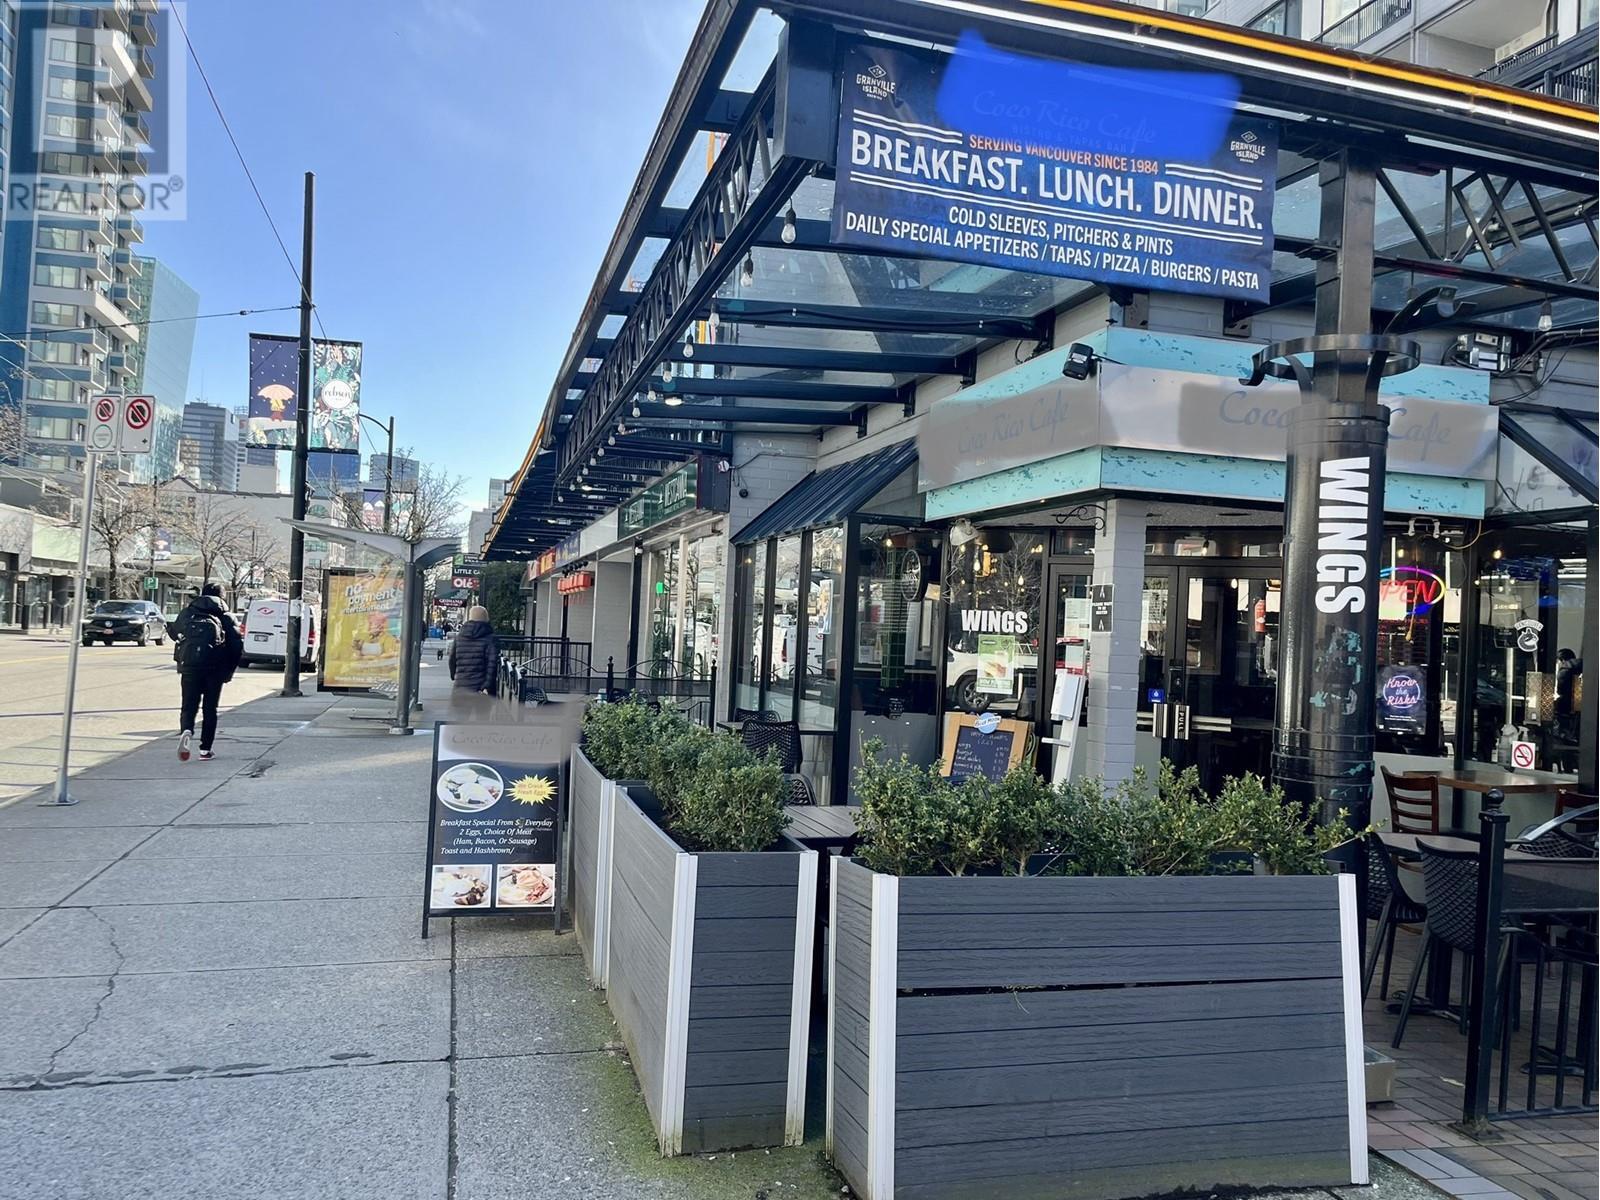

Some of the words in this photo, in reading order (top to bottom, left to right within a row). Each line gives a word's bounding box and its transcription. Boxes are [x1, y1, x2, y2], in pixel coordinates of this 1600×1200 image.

[856, 74, 896, 94] GRANVILLE
[862, 85, 888, 98] ISLAND
[969, 134, 1022, 152] SERVING
[1025, 143, 1092, 166] VANCOUVER
[1094, 155, 1128, 172] SINCE
[1130, 159, 1159, 175] 1984
[1230, 141, 1266, 156] GRANVILLE
[1236, 150, 1259, 160] ISLAND
[851, 129, 1028, 194] BREAKFAST.
[1039, 163, 1142, 212] LUNCH.
[1154, 181, 1263, 230] DINNER.
[949, 206, 986, 228] COLD
[989, 213, 1050, 241] SLEEVES,
[1054, 222, 1119, 249] PITCHERS
[1122, 232, 1132, 249] &
[1135, 236, 1174, 256] PINTS
[846, 211, 889, 236] DAILY
[891, 219, 951, 247] SPECIAL
[954, 230, 1039, 259] APPETIZERS
[1041, 243, 1047, 262] /
[1050, 244, 1091, 267] TAPAS
[1094, 251, 1100, 269] /
[1102, 253, 1140, 274] PIZZA
[1143, 258, 1149, 276] /
[1151, 259, 1211, 284] BURGERS
[1214, 268, 1219, 285] /
[1222, 269, 1260, 290] PASTA
[1219, 391, 1296, 428] Coco
[1388, 408, 1450, 461] Cafe
[1315, 456, 1370, 614] WINGS
[1380, 579, 1439, 603] PEN
[961, 609, 1028, 634] WINGS
[1387, 678, 1417, 689] Know
[1395, 688, 1408, 696] the
[1387, 695, 1418, 706] Risks
[440, 818, 471, 827] Breakfast
[472, 818, 496, 827] Special
[497, 819, 514, 827] From
[525, 818, 553, 828] Everyday
[465, 828, 482, 836] Eggs,
[507, 828, 515, 836] Of
[453, 838, 473, 846] (Ham,
[508, 838, 538, 846] Sausage)
[441, 847, 459, 855] Toast
